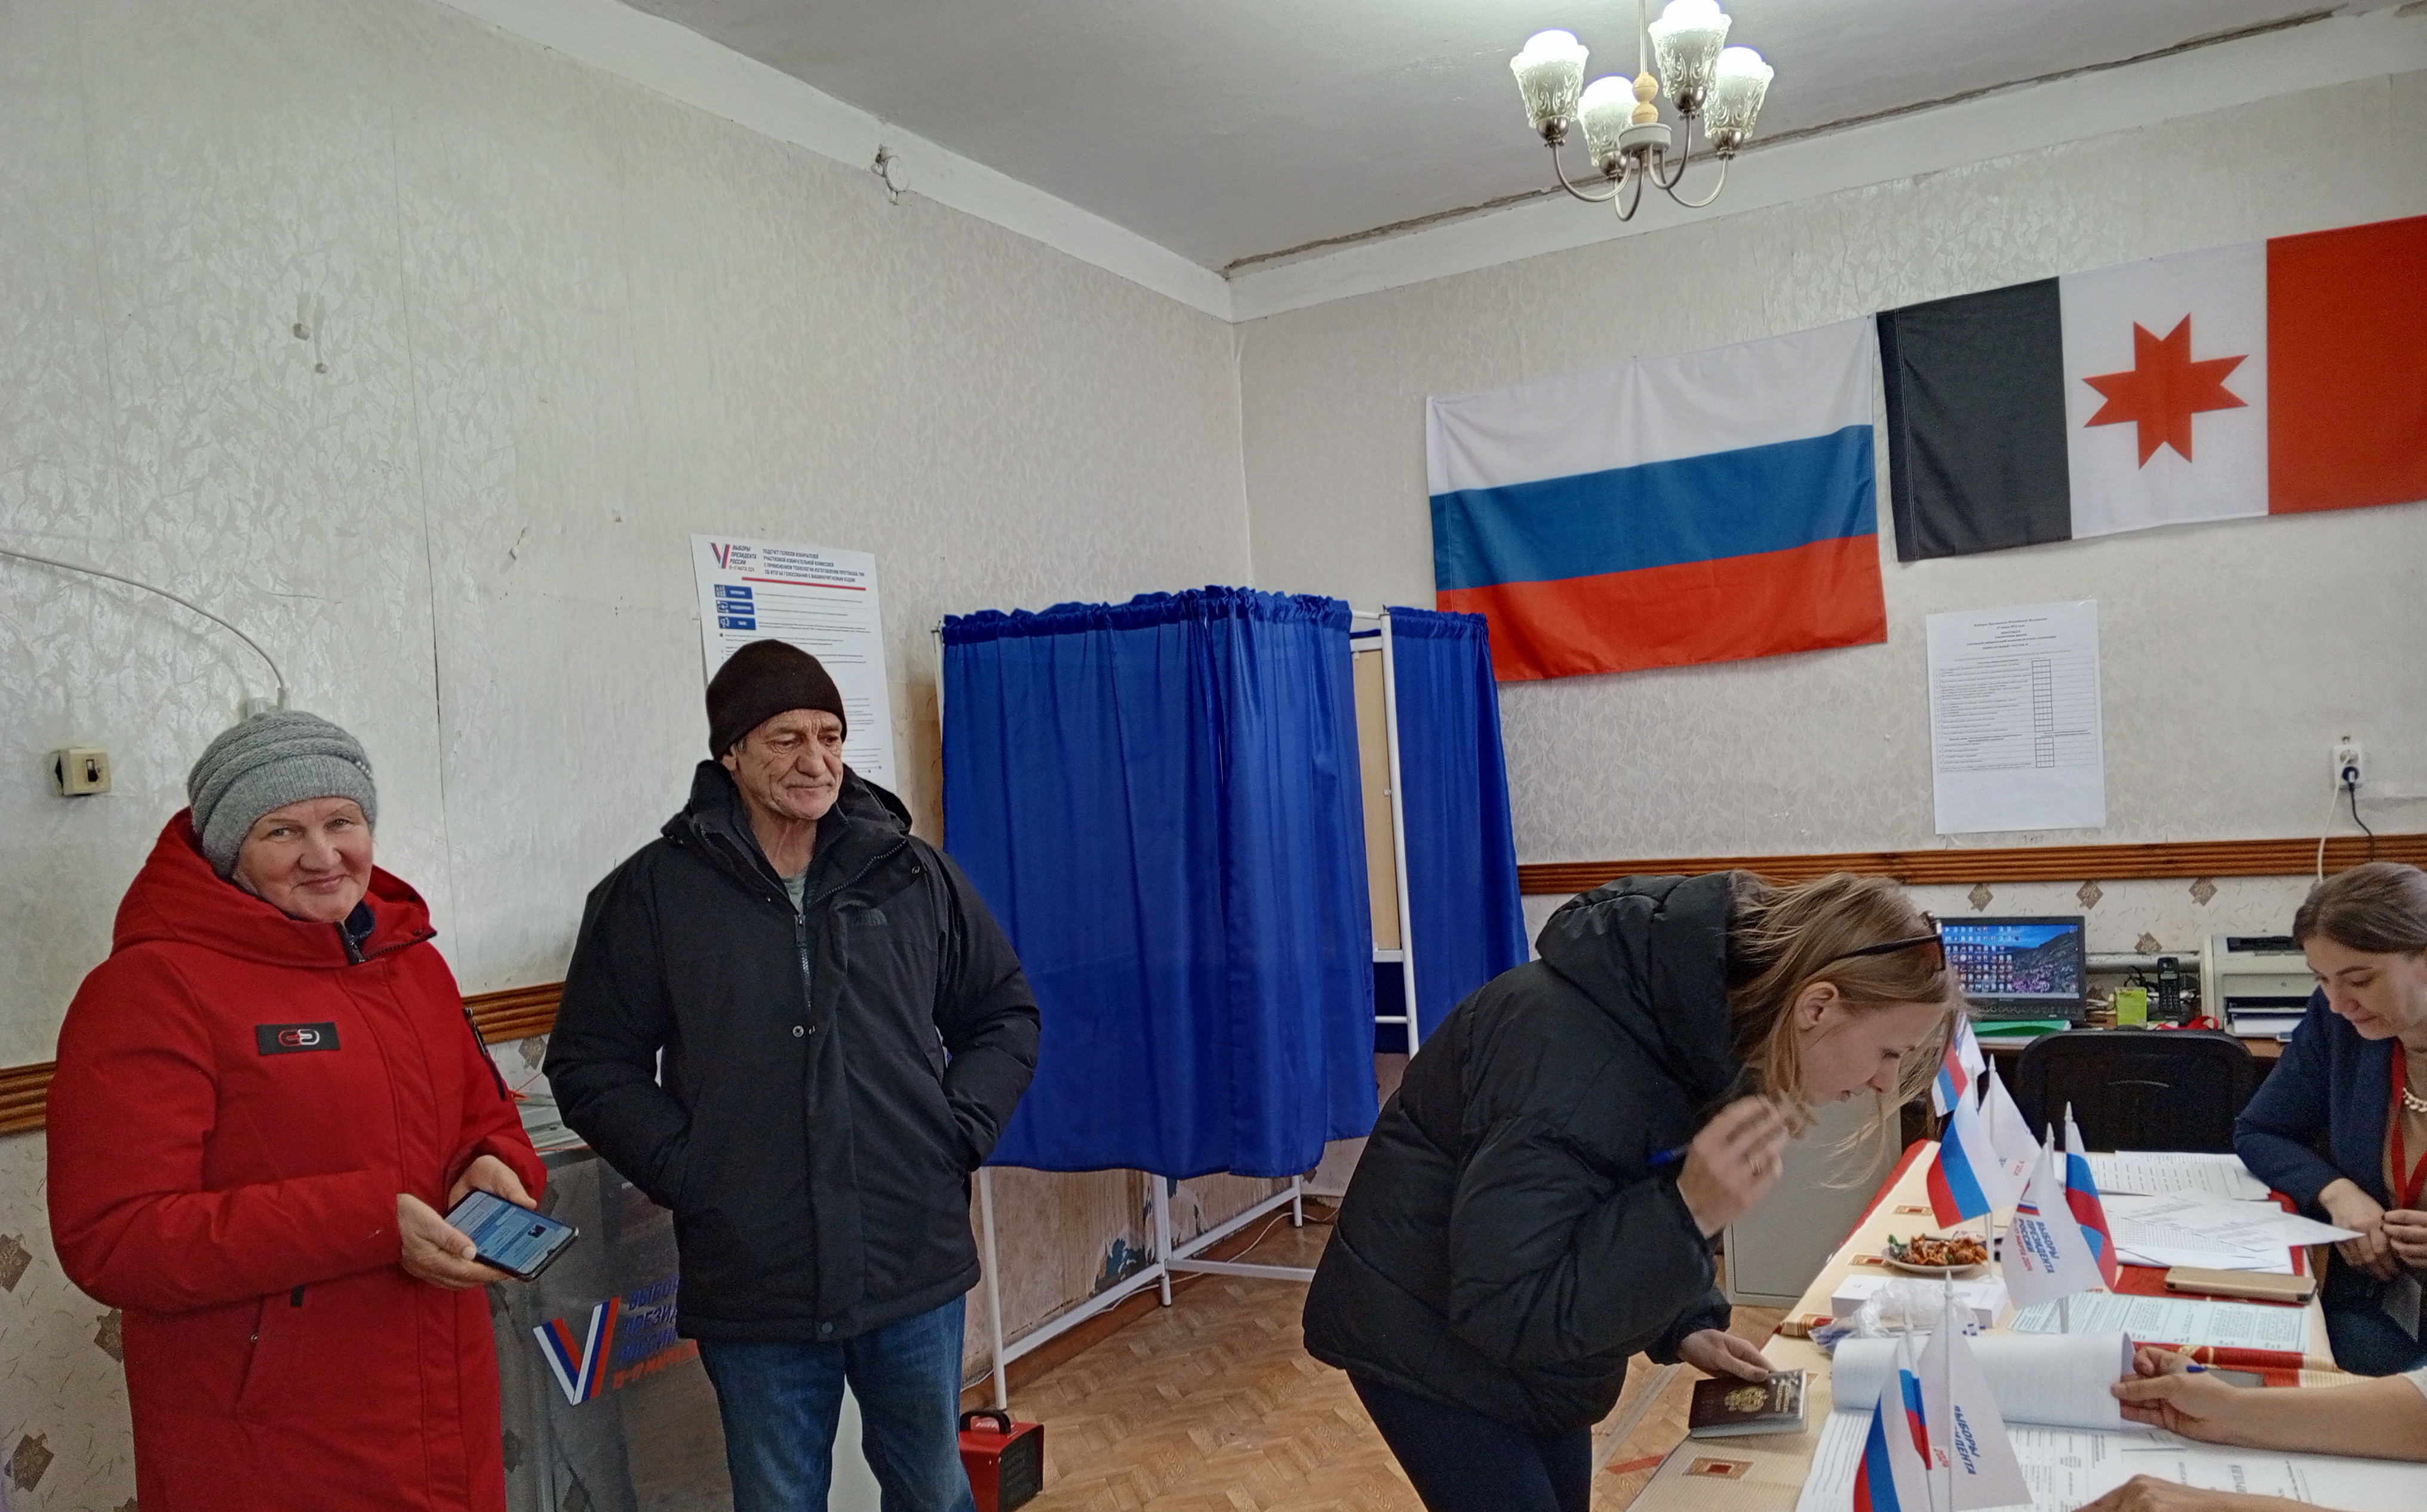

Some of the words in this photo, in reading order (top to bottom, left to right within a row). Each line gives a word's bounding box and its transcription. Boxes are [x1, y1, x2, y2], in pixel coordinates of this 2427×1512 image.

[2019, 1219, 2035, 1252] РОССИИ
[2026, 1219, 2055, 1273] ПРЕЗИДЕНТА
[2036, 1221, 2060, 1259] ВЫБОРЫ
